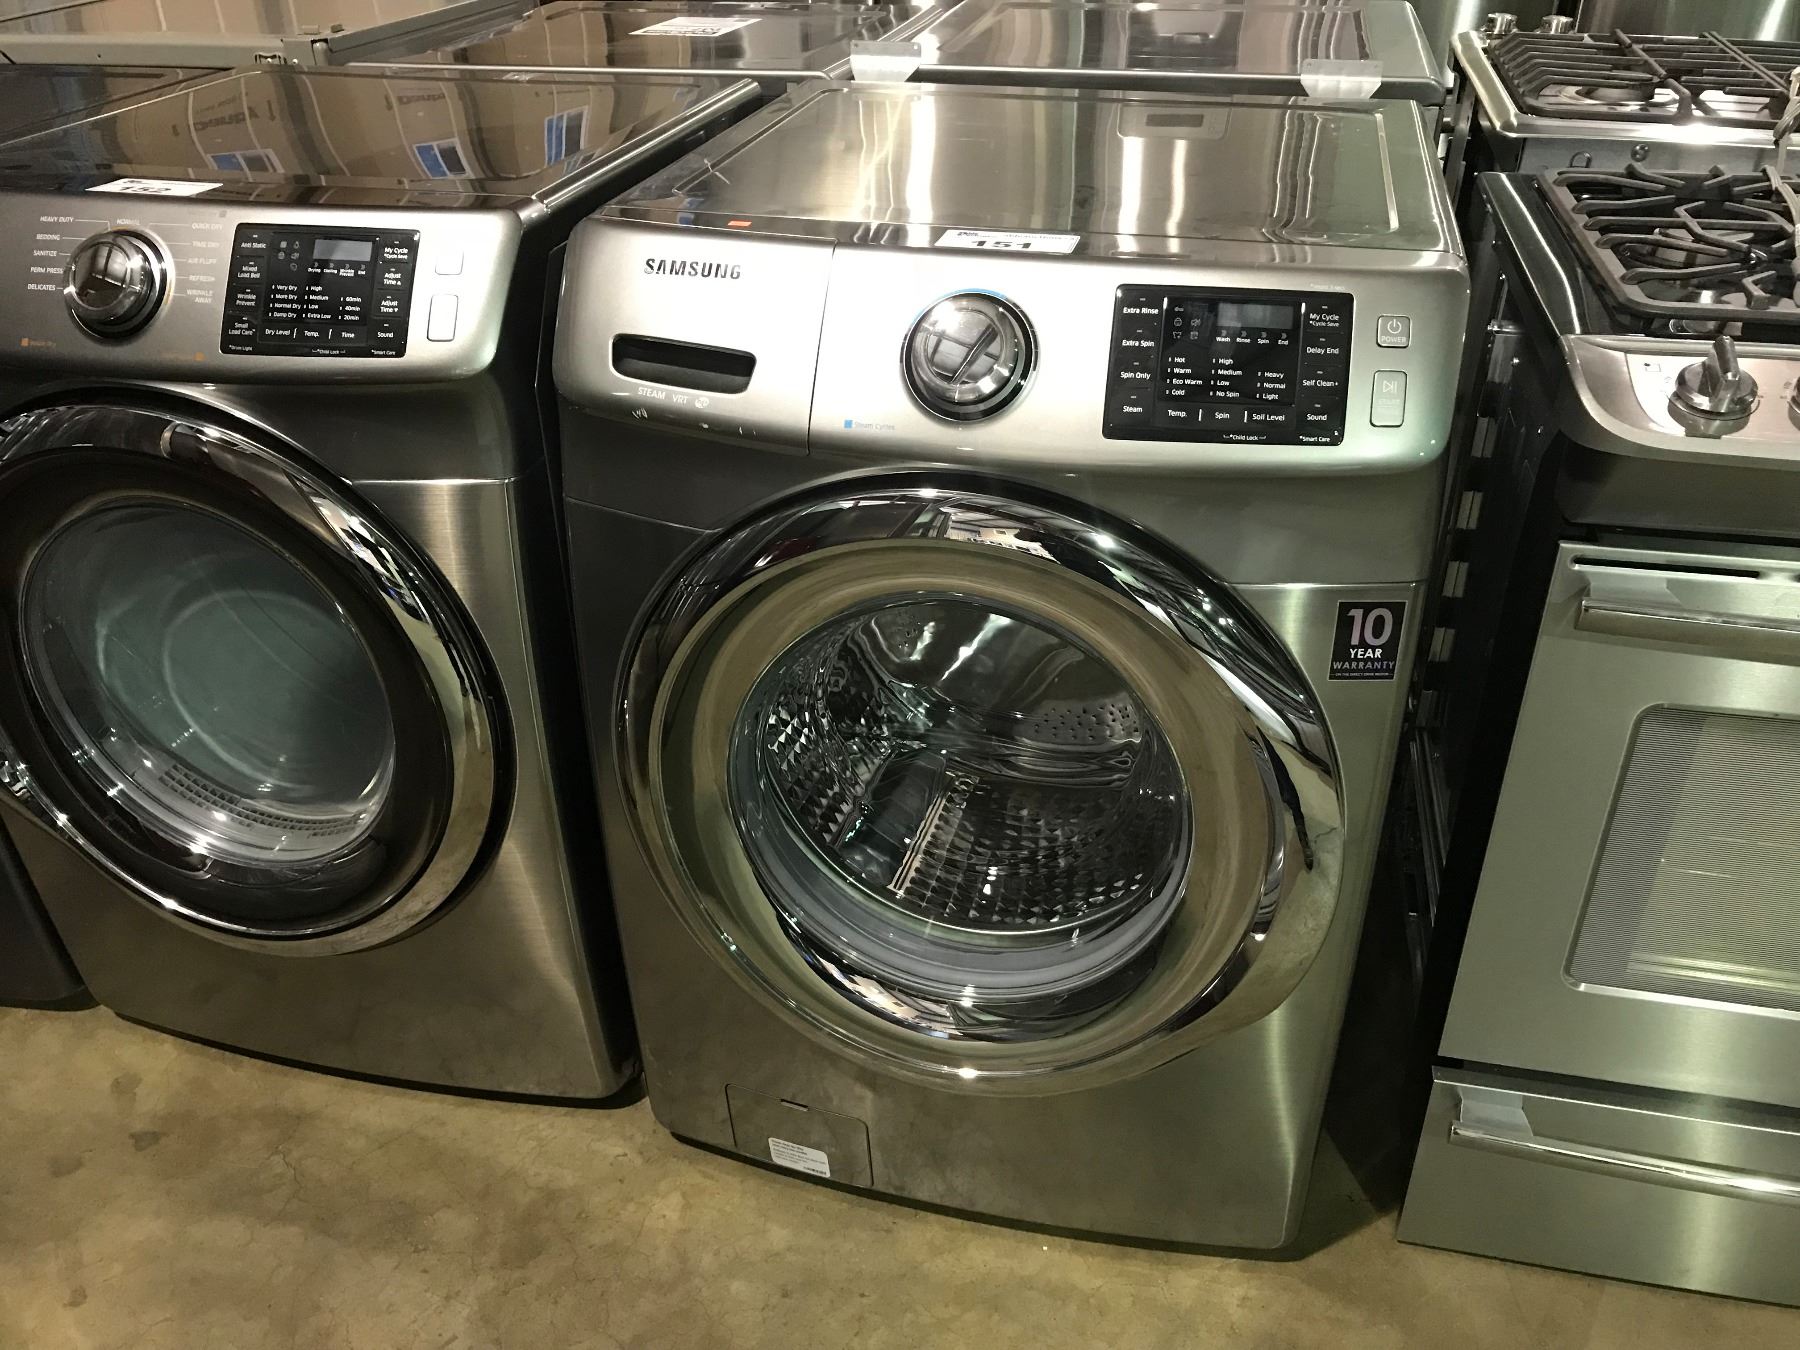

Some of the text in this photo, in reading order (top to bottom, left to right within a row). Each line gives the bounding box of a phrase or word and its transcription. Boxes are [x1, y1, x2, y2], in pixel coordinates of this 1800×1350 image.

[972, 240, 1032, 249] 151
[644, 258, 741, 280] SAMSUNG
[638, 387, 666, 400] STEAM
[672, 394, 688, 404] VRT
[1347, 608, 1393, 646] 10
[1350, 648, 1382, 658] YEAR
[1333, 661, 1395, 669] WARRANTY
